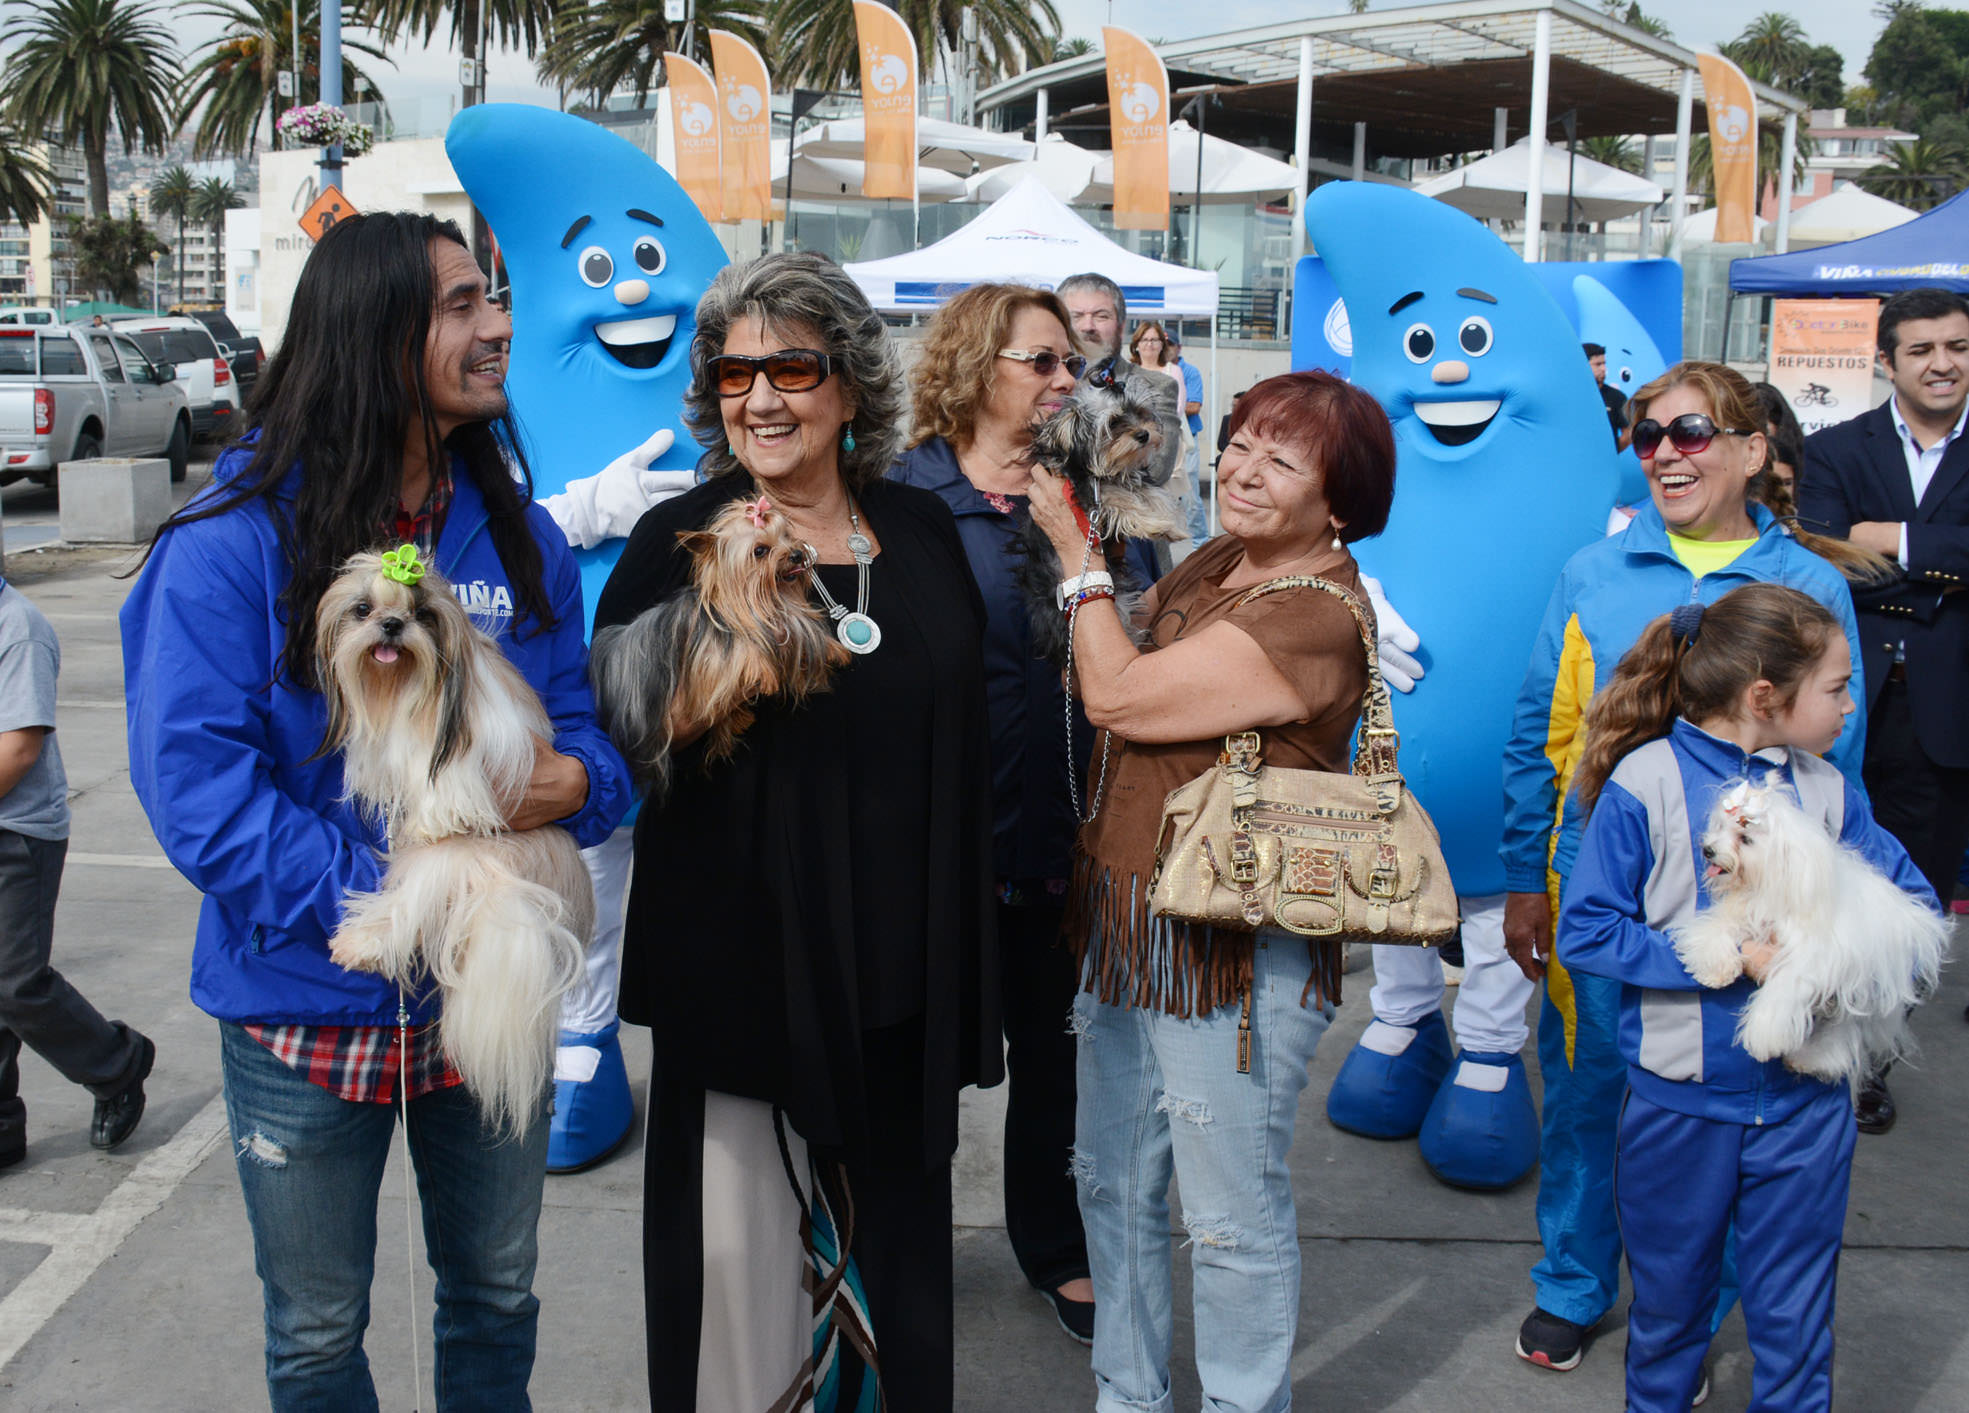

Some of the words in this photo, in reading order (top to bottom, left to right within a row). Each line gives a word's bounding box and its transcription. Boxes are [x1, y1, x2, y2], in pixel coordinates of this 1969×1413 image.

[1819, 264, 1873, 279] VIÑA
[1840, 320, 1870, 329] Bike
[1777, 355, 1868, 369] REPUESTOS
